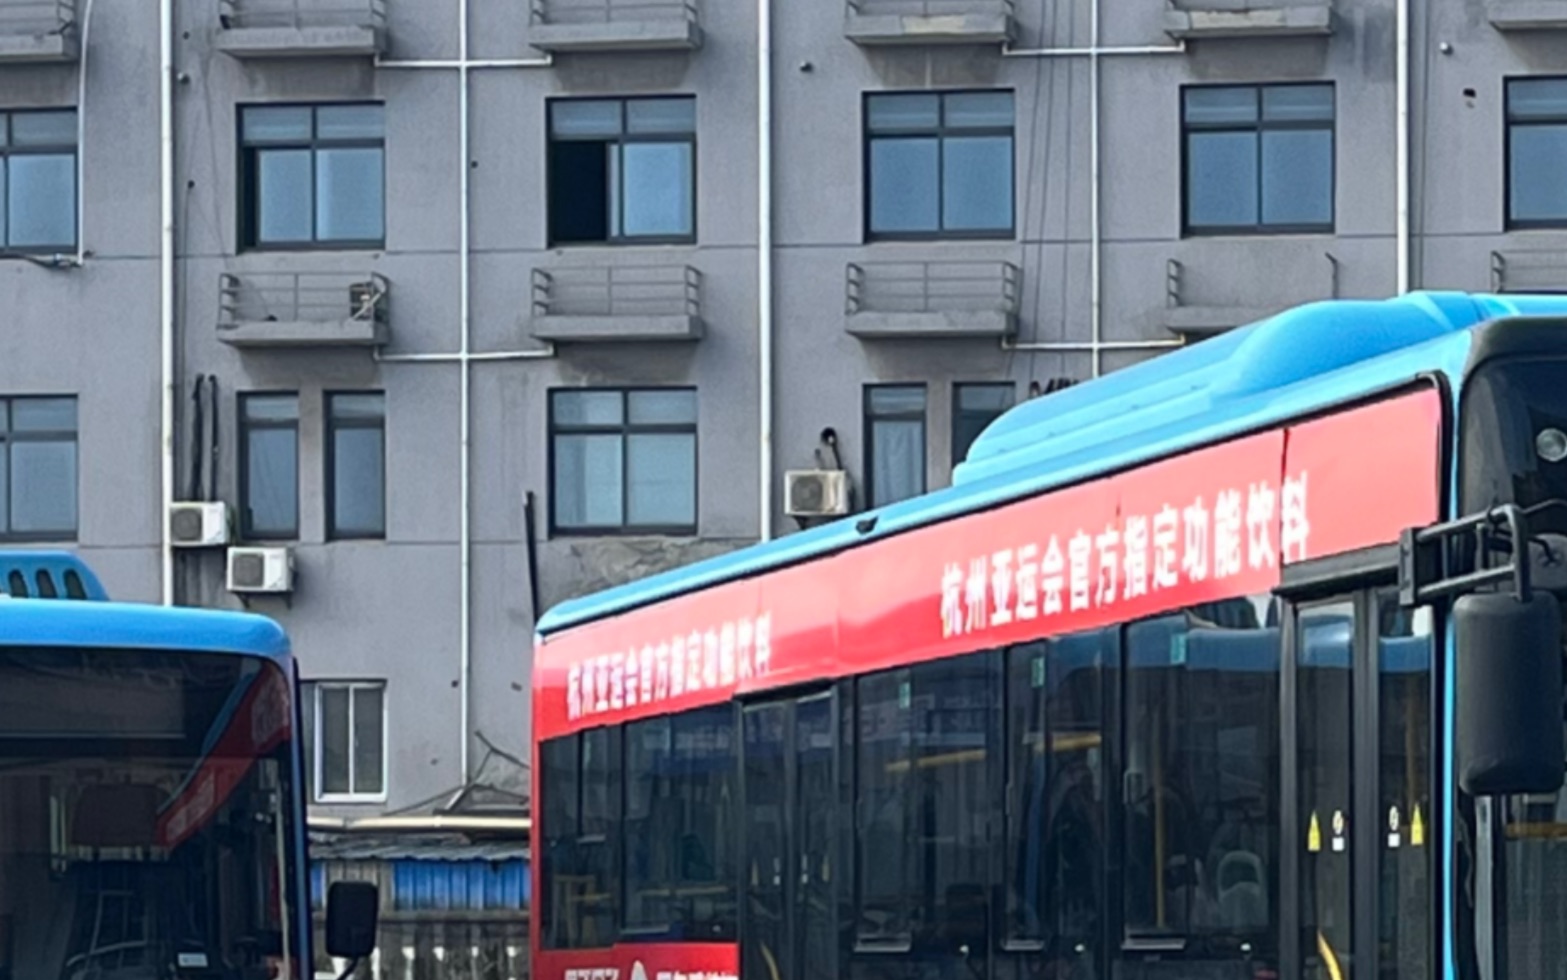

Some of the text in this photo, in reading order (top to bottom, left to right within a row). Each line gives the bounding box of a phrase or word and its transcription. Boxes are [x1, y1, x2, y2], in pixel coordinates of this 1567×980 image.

[940, 470, 1311, 638] 杭州亚运会官方指定功能饮料
